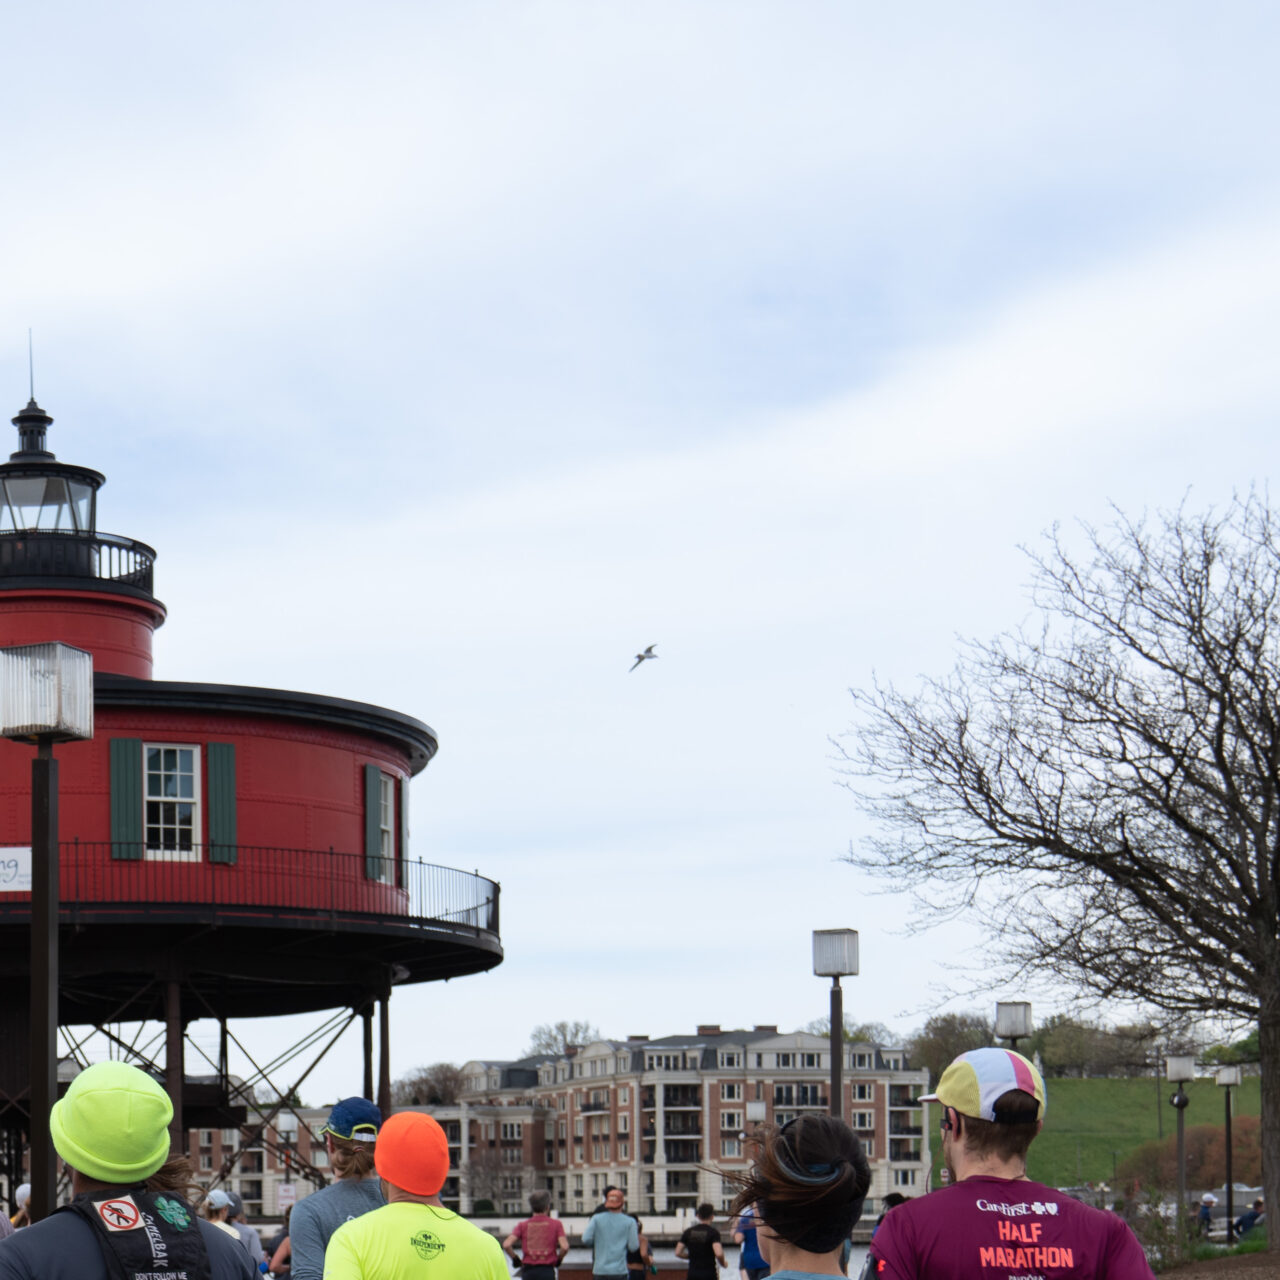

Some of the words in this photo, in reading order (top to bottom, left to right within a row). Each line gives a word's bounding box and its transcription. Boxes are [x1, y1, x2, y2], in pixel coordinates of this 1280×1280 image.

[976, 1199, 1030, 1217] CareFirst
[141, 1212, 168, 1267] CAMELBAK
[998, 1220, 1042, 1243] HALF
[979, 1246, 1074, 1268] MARATHON
[136, 1273, 152, 1280] DON'T
[153, 1273, 176, 1280] FOLLOW
[178, 1272, 187, 1280] ME
